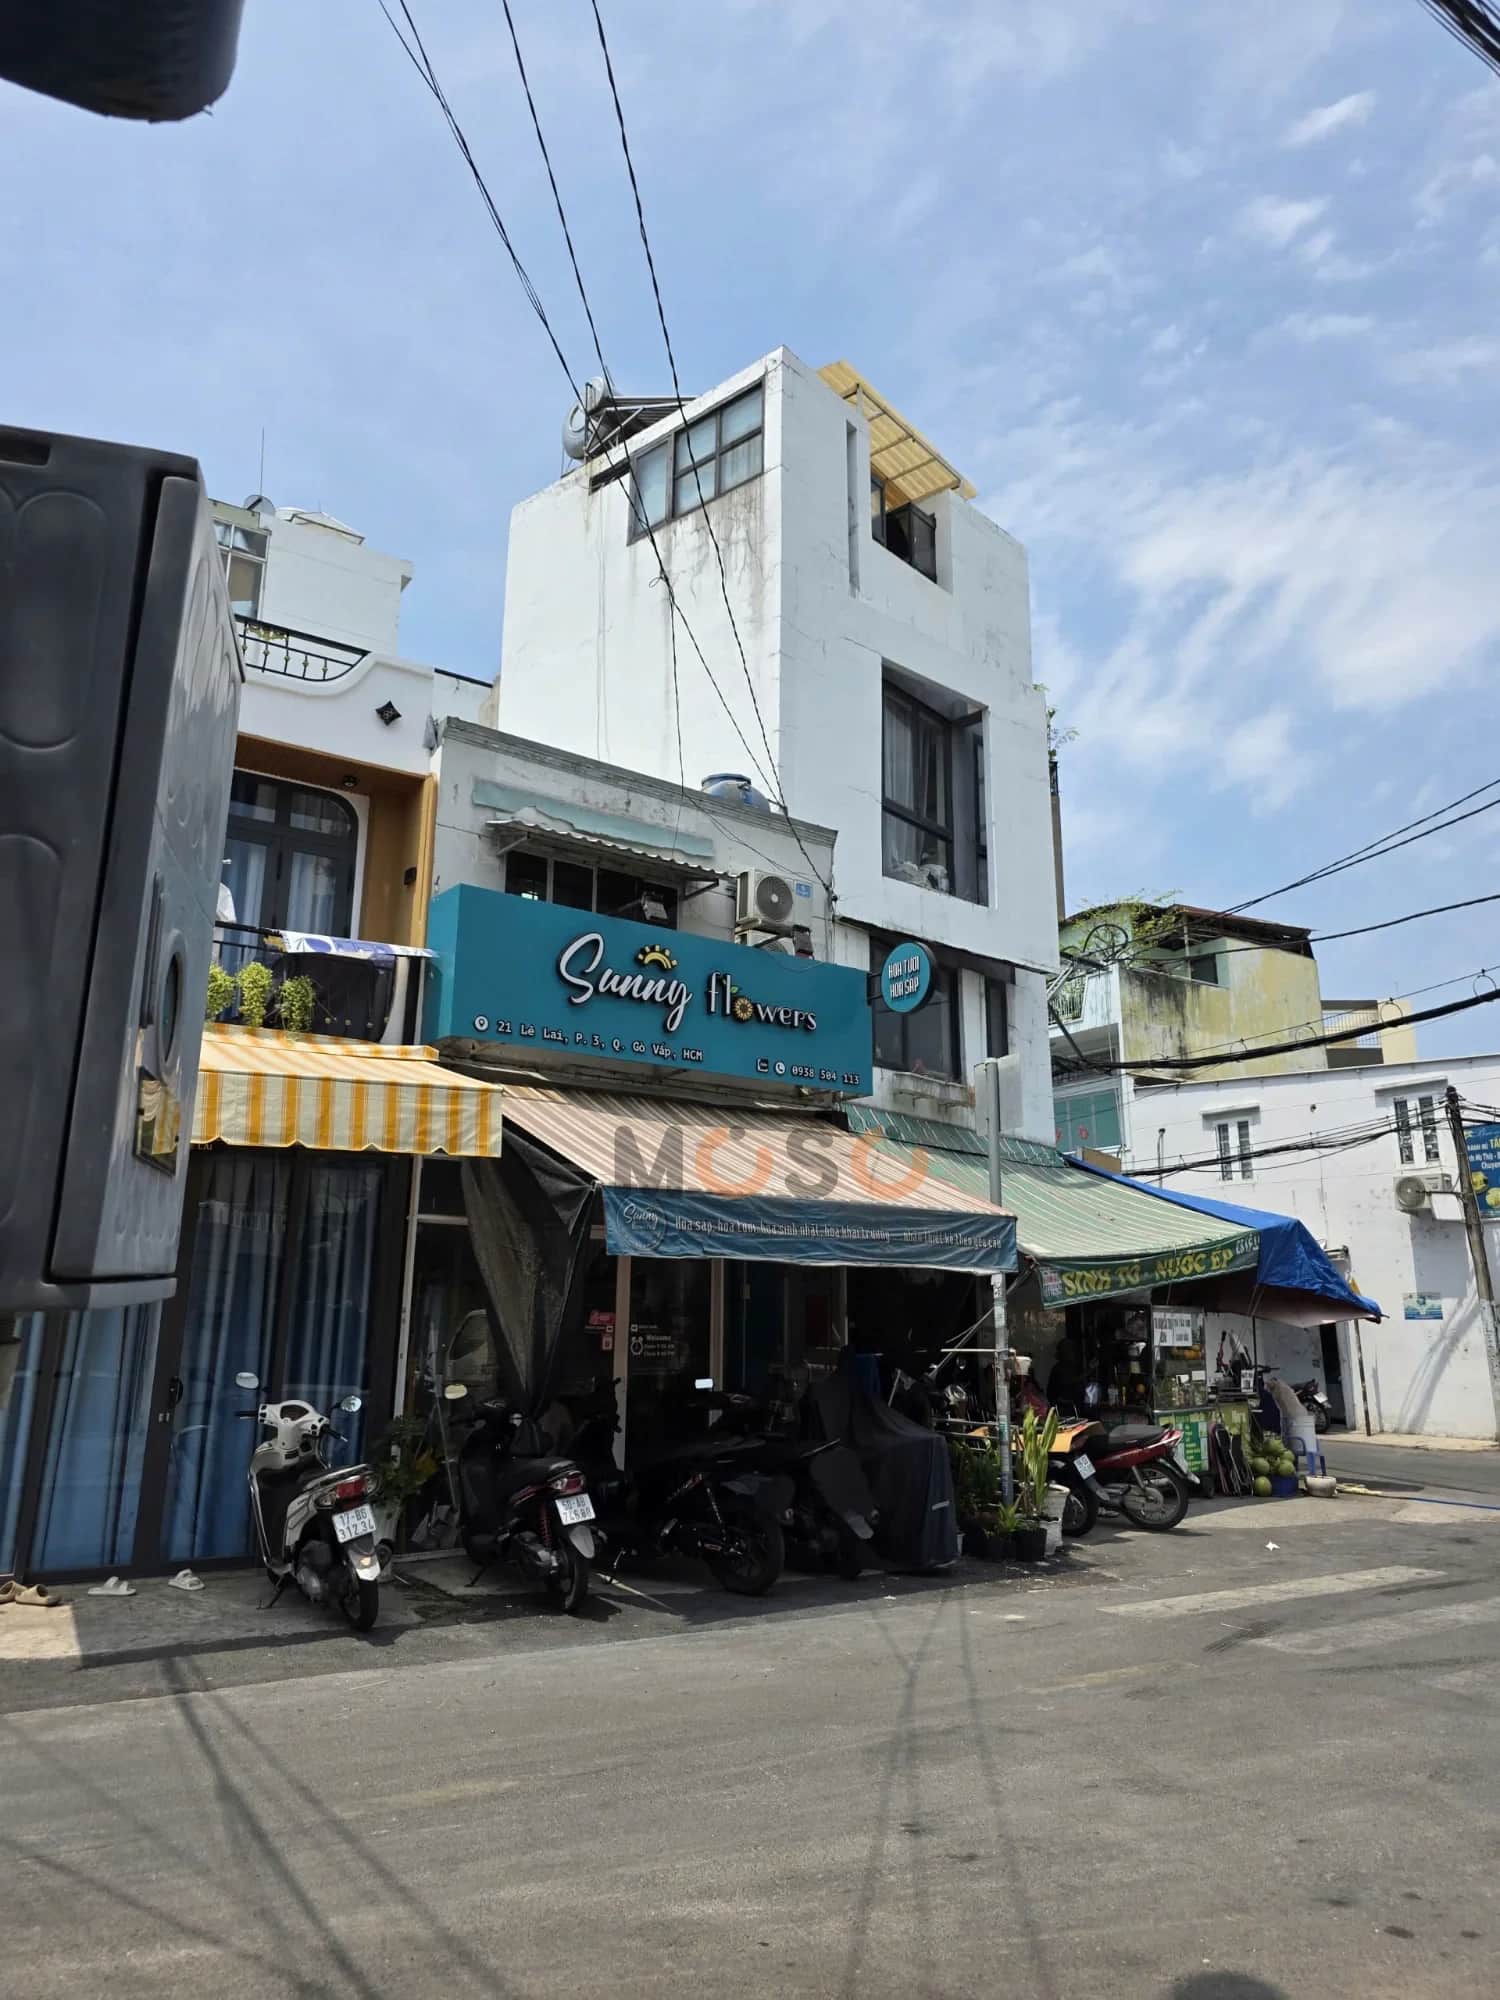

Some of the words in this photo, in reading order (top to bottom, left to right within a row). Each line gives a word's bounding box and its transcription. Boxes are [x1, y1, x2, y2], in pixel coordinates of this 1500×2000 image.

[559, 932, 693, 1032] Sunny
[888, 961, 902, 979] HOA
[889, 982, 904, 998] HOA
[497, 1020, 512, 1033] 21
[521, 1023, 536, 1036] Lê
[544, 1027, 568, 1043] Lai,
[576, 1032, 588, 1044] P.
[593, 1035, 605, 1048] 3,
[613, 1039, 625, 1051] Q.
[633, 1041, 646, 1053] Gò
[683, 1049, 704, 1061] HCM
[792, 1065, 815, 1078] 0938
[843, 1073, 859, 1085] 113
[623, 1202, 659, 1227] Sunny
[1061, 1269, 1112, 1297] SINH
